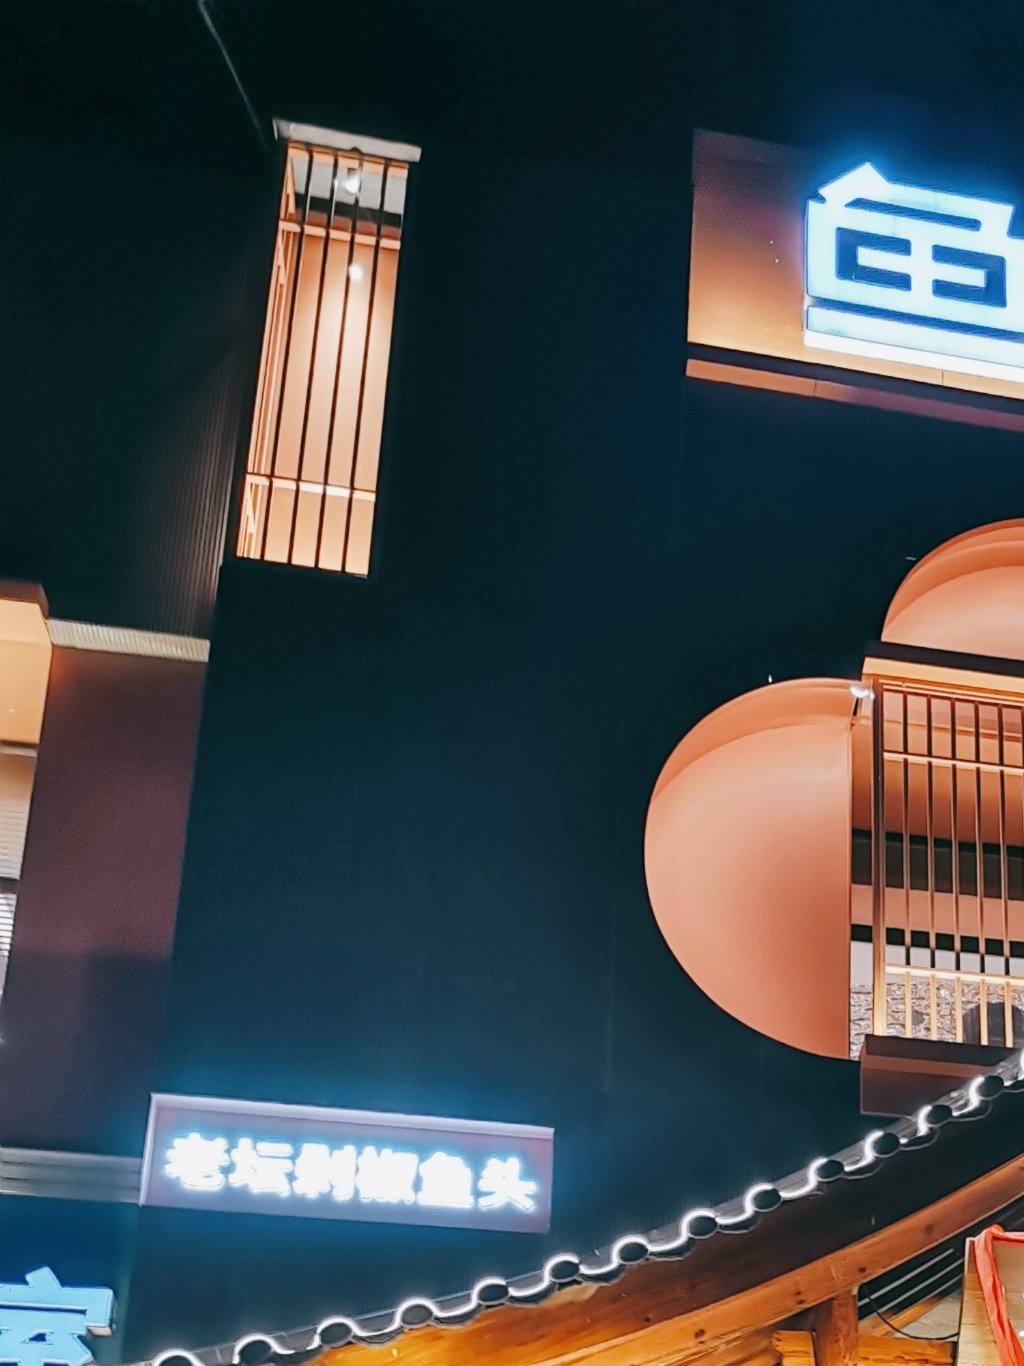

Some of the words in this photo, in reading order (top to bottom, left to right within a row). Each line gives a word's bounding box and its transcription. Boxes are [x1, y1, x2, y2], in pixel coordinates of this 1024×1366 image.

[164, 1132, 538, 1211] 老坛剁椒鱼头
